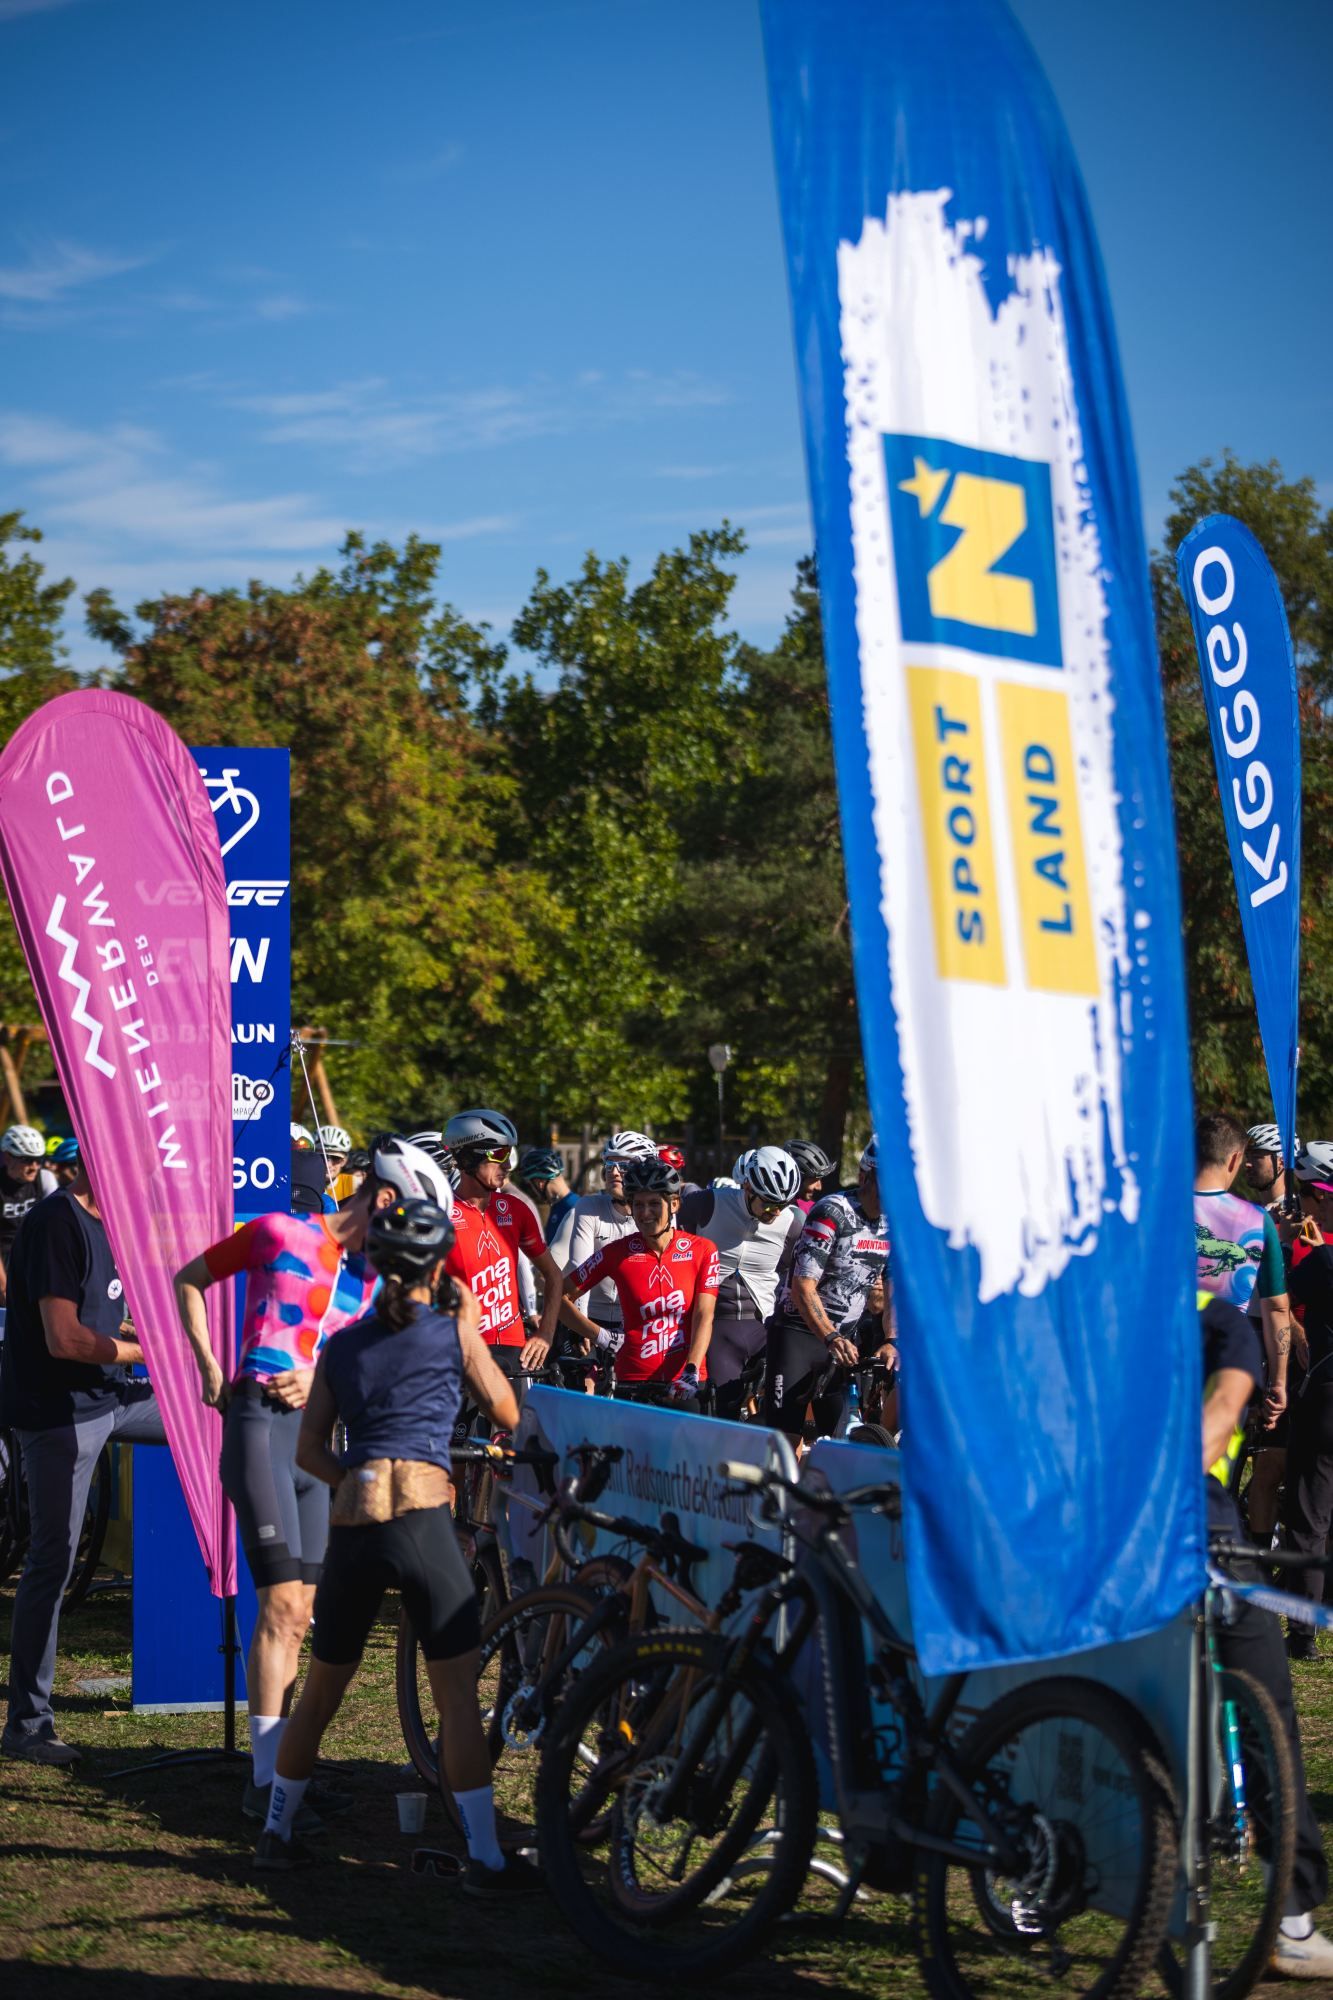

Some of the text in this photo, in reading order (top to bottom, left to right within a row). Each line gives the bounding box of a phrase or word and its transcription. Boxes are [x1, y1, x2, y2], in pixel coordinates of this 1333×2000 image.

[934, 704, 985, 944] SPORT
[1023, 742, 1075, 936] LAND
[471, 1256, 510, 1293] ma
[478, 1301, 513, 1334] alia
[639, 1289, 686, 1321] ma
[641, 1306, 686, 1341] roit
[639, 1329, 686, 1359] alia
[271, 1785, 288, 1822] KEEP
